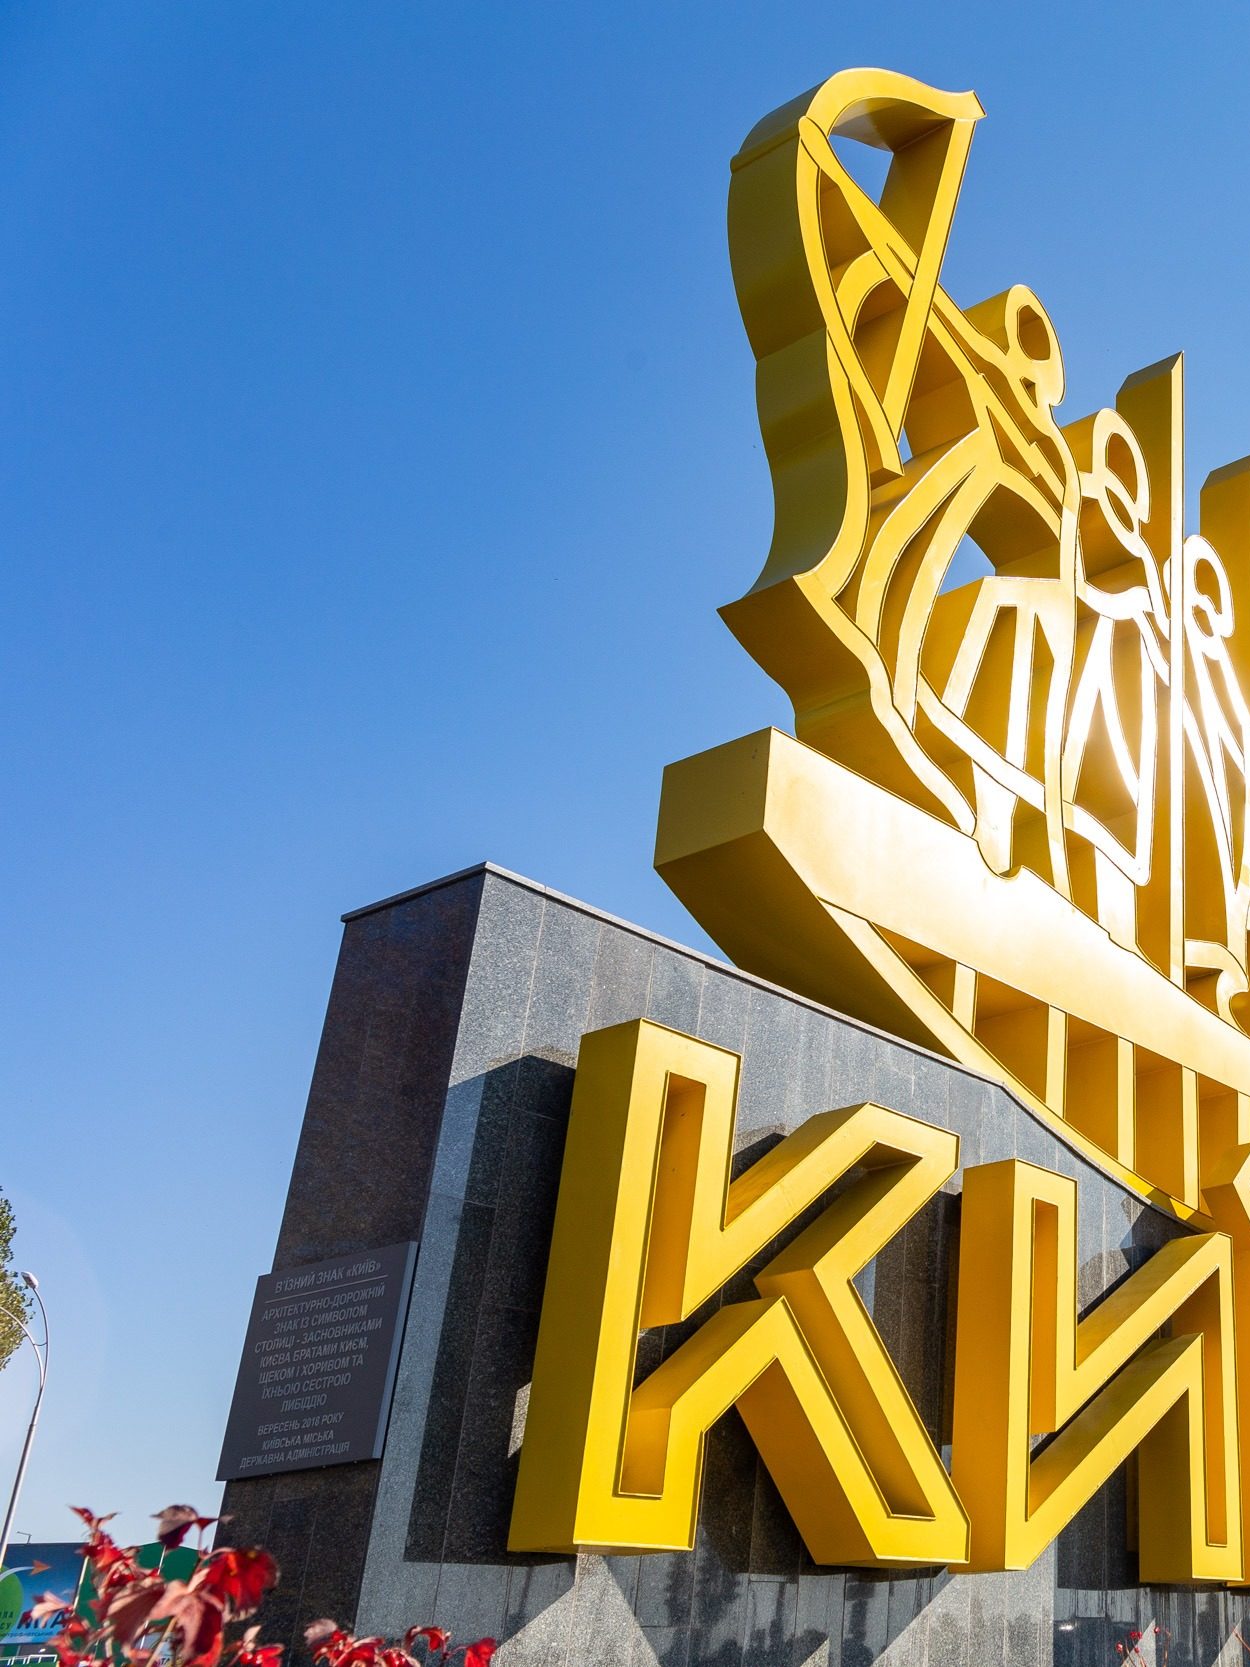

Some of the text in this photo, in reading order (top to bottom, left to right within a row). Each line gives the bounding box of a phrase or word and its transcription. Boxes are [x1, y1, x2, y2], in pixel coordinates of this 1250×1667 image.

[316, 1267, 346, 1285] ЗНАК
[347, 1259, 381, 1277] «КИЇВ»
[262, 1282, 385, 1321] АРХІТЕКТУРНО-ДОРОЖНІЙ
[274, 1304, 368, 1334] ЗНАК ІЗ СИМВОЛОМ
[255, 1336, 295, 1353] СТОЛИЦІ
[301, 1317, 382, 1344] ЗАСНОВНИКАМИ
[260, 1337, 369, 1368] КИЄВА БРАТАМИ КИЄМ,
[258, 1366, 295, 1386] ЩЕКОМ
[301, 1356, 350, 1376] ХОРИВОМ
[352, 1354, 364, 1367] ТА
[262, 1373, 351, 1399] ЇХНЬОЮ СЕСТРОЮ
[280, 1394, 327, 1413] ЛИБІДДЮ
[257, 1412, 345, 1436] ВЕРЕСЕНЬ 2018 РОКУ
[261, 1430, 334, 1451] КИЇВСЬКА МІСЬКА
[239, 1441, 351, 1470] ДЕРЖАВНА АДМІНІСТРАЦІЯ
